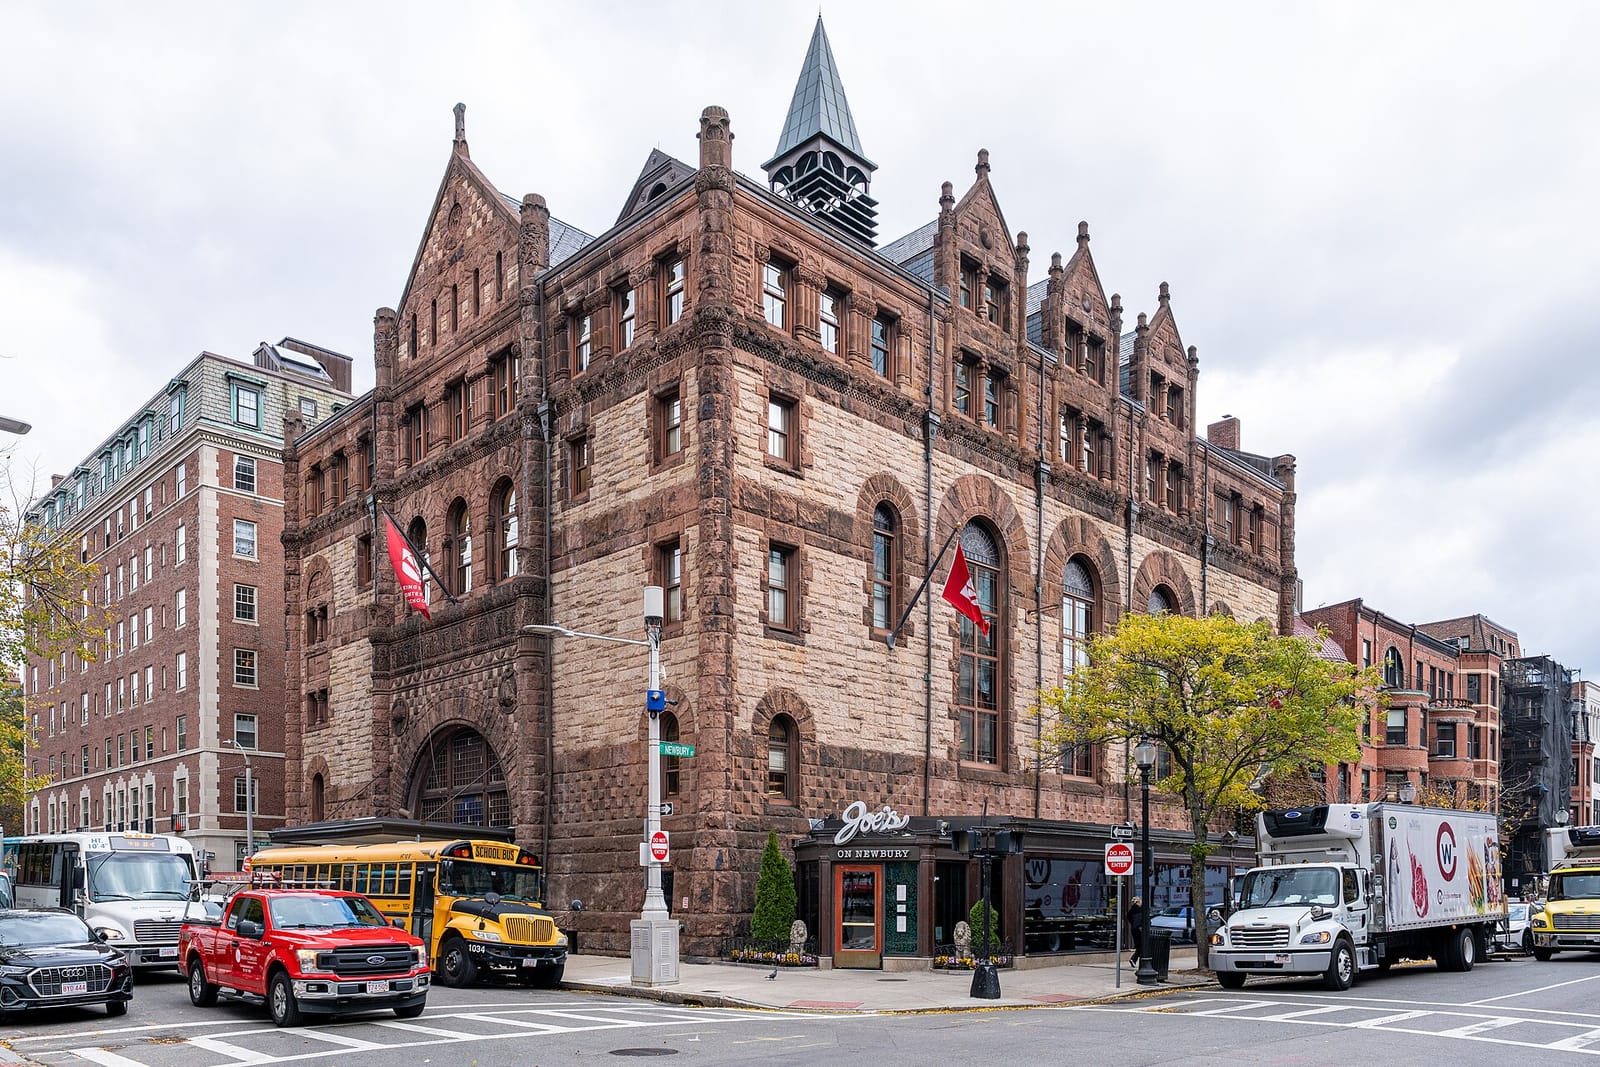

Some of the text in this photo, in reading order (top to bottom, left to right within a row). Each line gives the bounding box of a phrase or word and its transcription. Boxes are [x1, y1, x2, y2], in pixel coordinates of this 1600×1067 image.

[664, 745, 690, 756] NEWBURY
[834, 801, 910, 846] Joe's
[475, 846, 515, 861] SCHOOL BUS
[837, 849, 910, 858] ON NEWBURY
[468, 944, 485, 954] 1034
